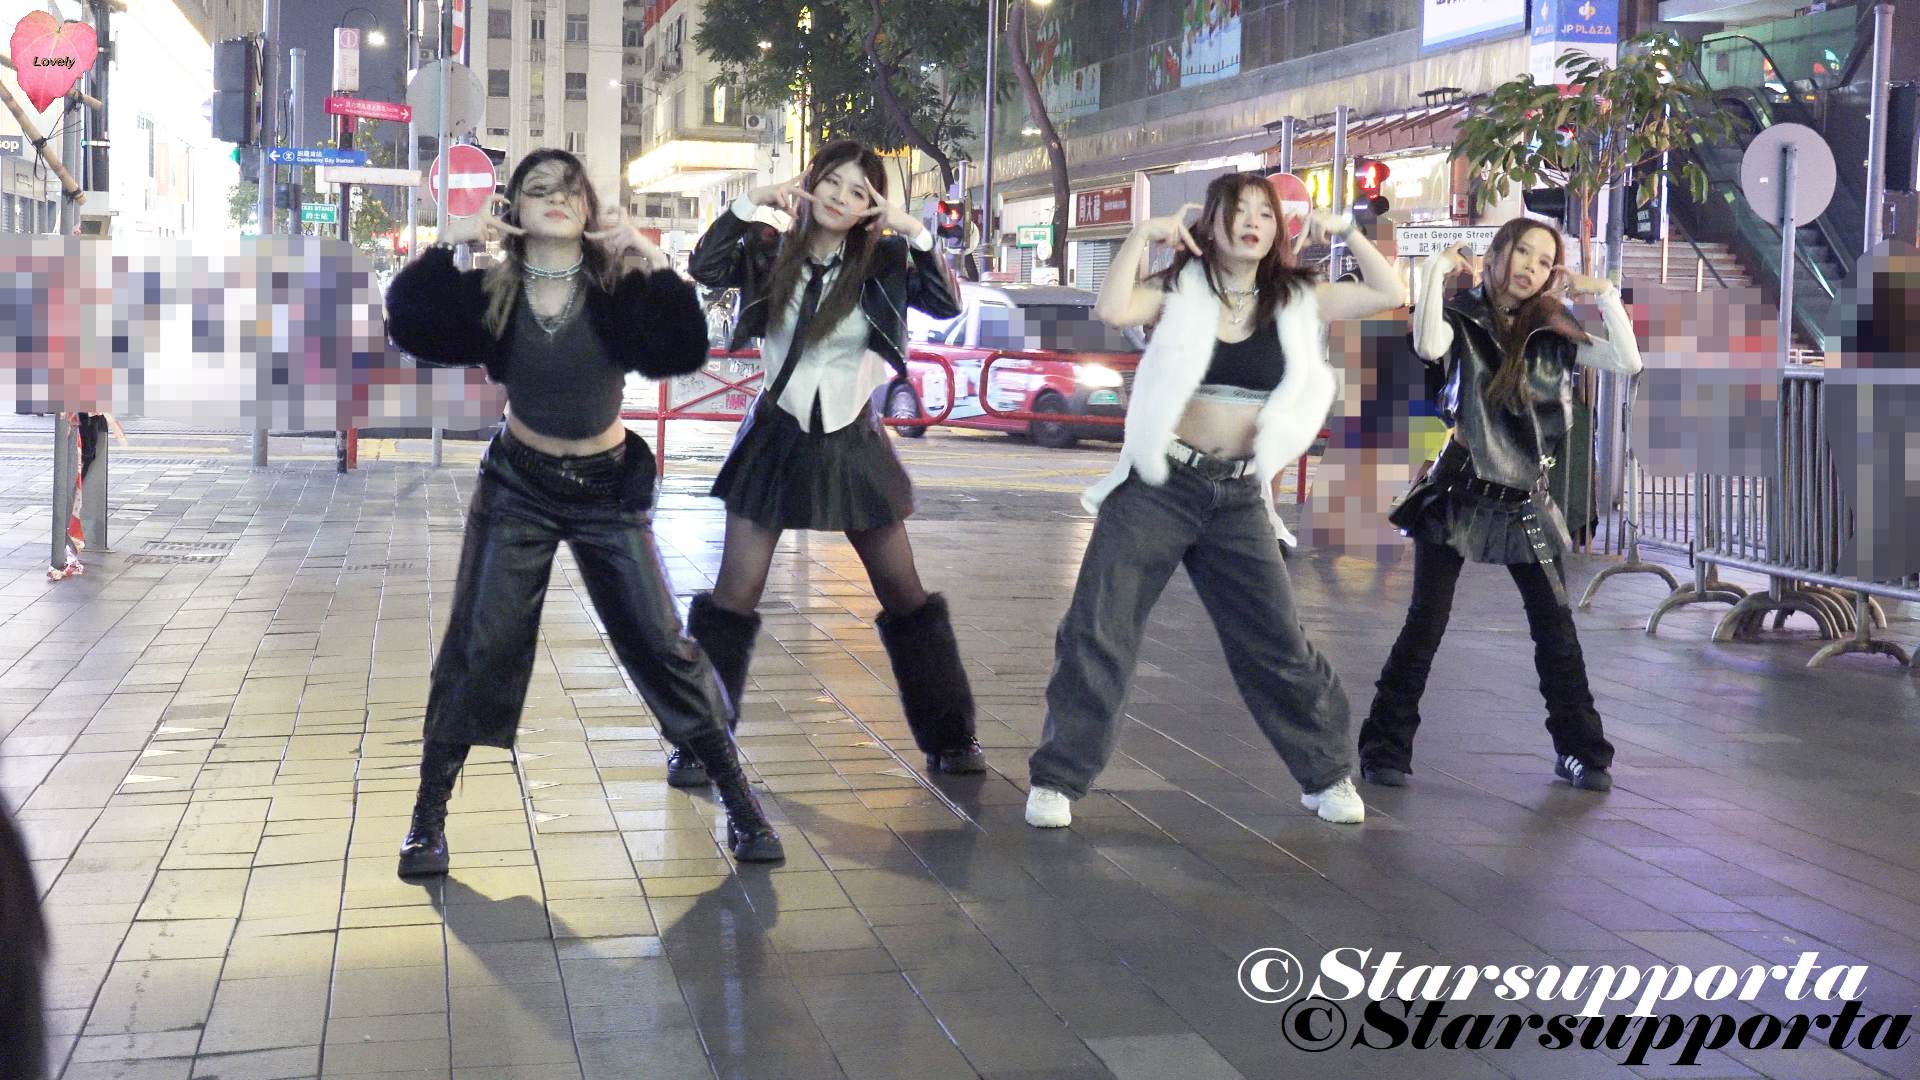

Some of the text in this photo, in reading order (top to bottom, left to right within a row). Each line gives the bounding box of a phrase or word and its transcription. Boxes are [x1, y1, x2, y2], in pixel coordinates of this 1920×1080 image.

[1561, 24, 1573, 33] JP
[1575, 25, 1612, 34] PLAZA
[1403, 230, 1494, 240] Great George Street
